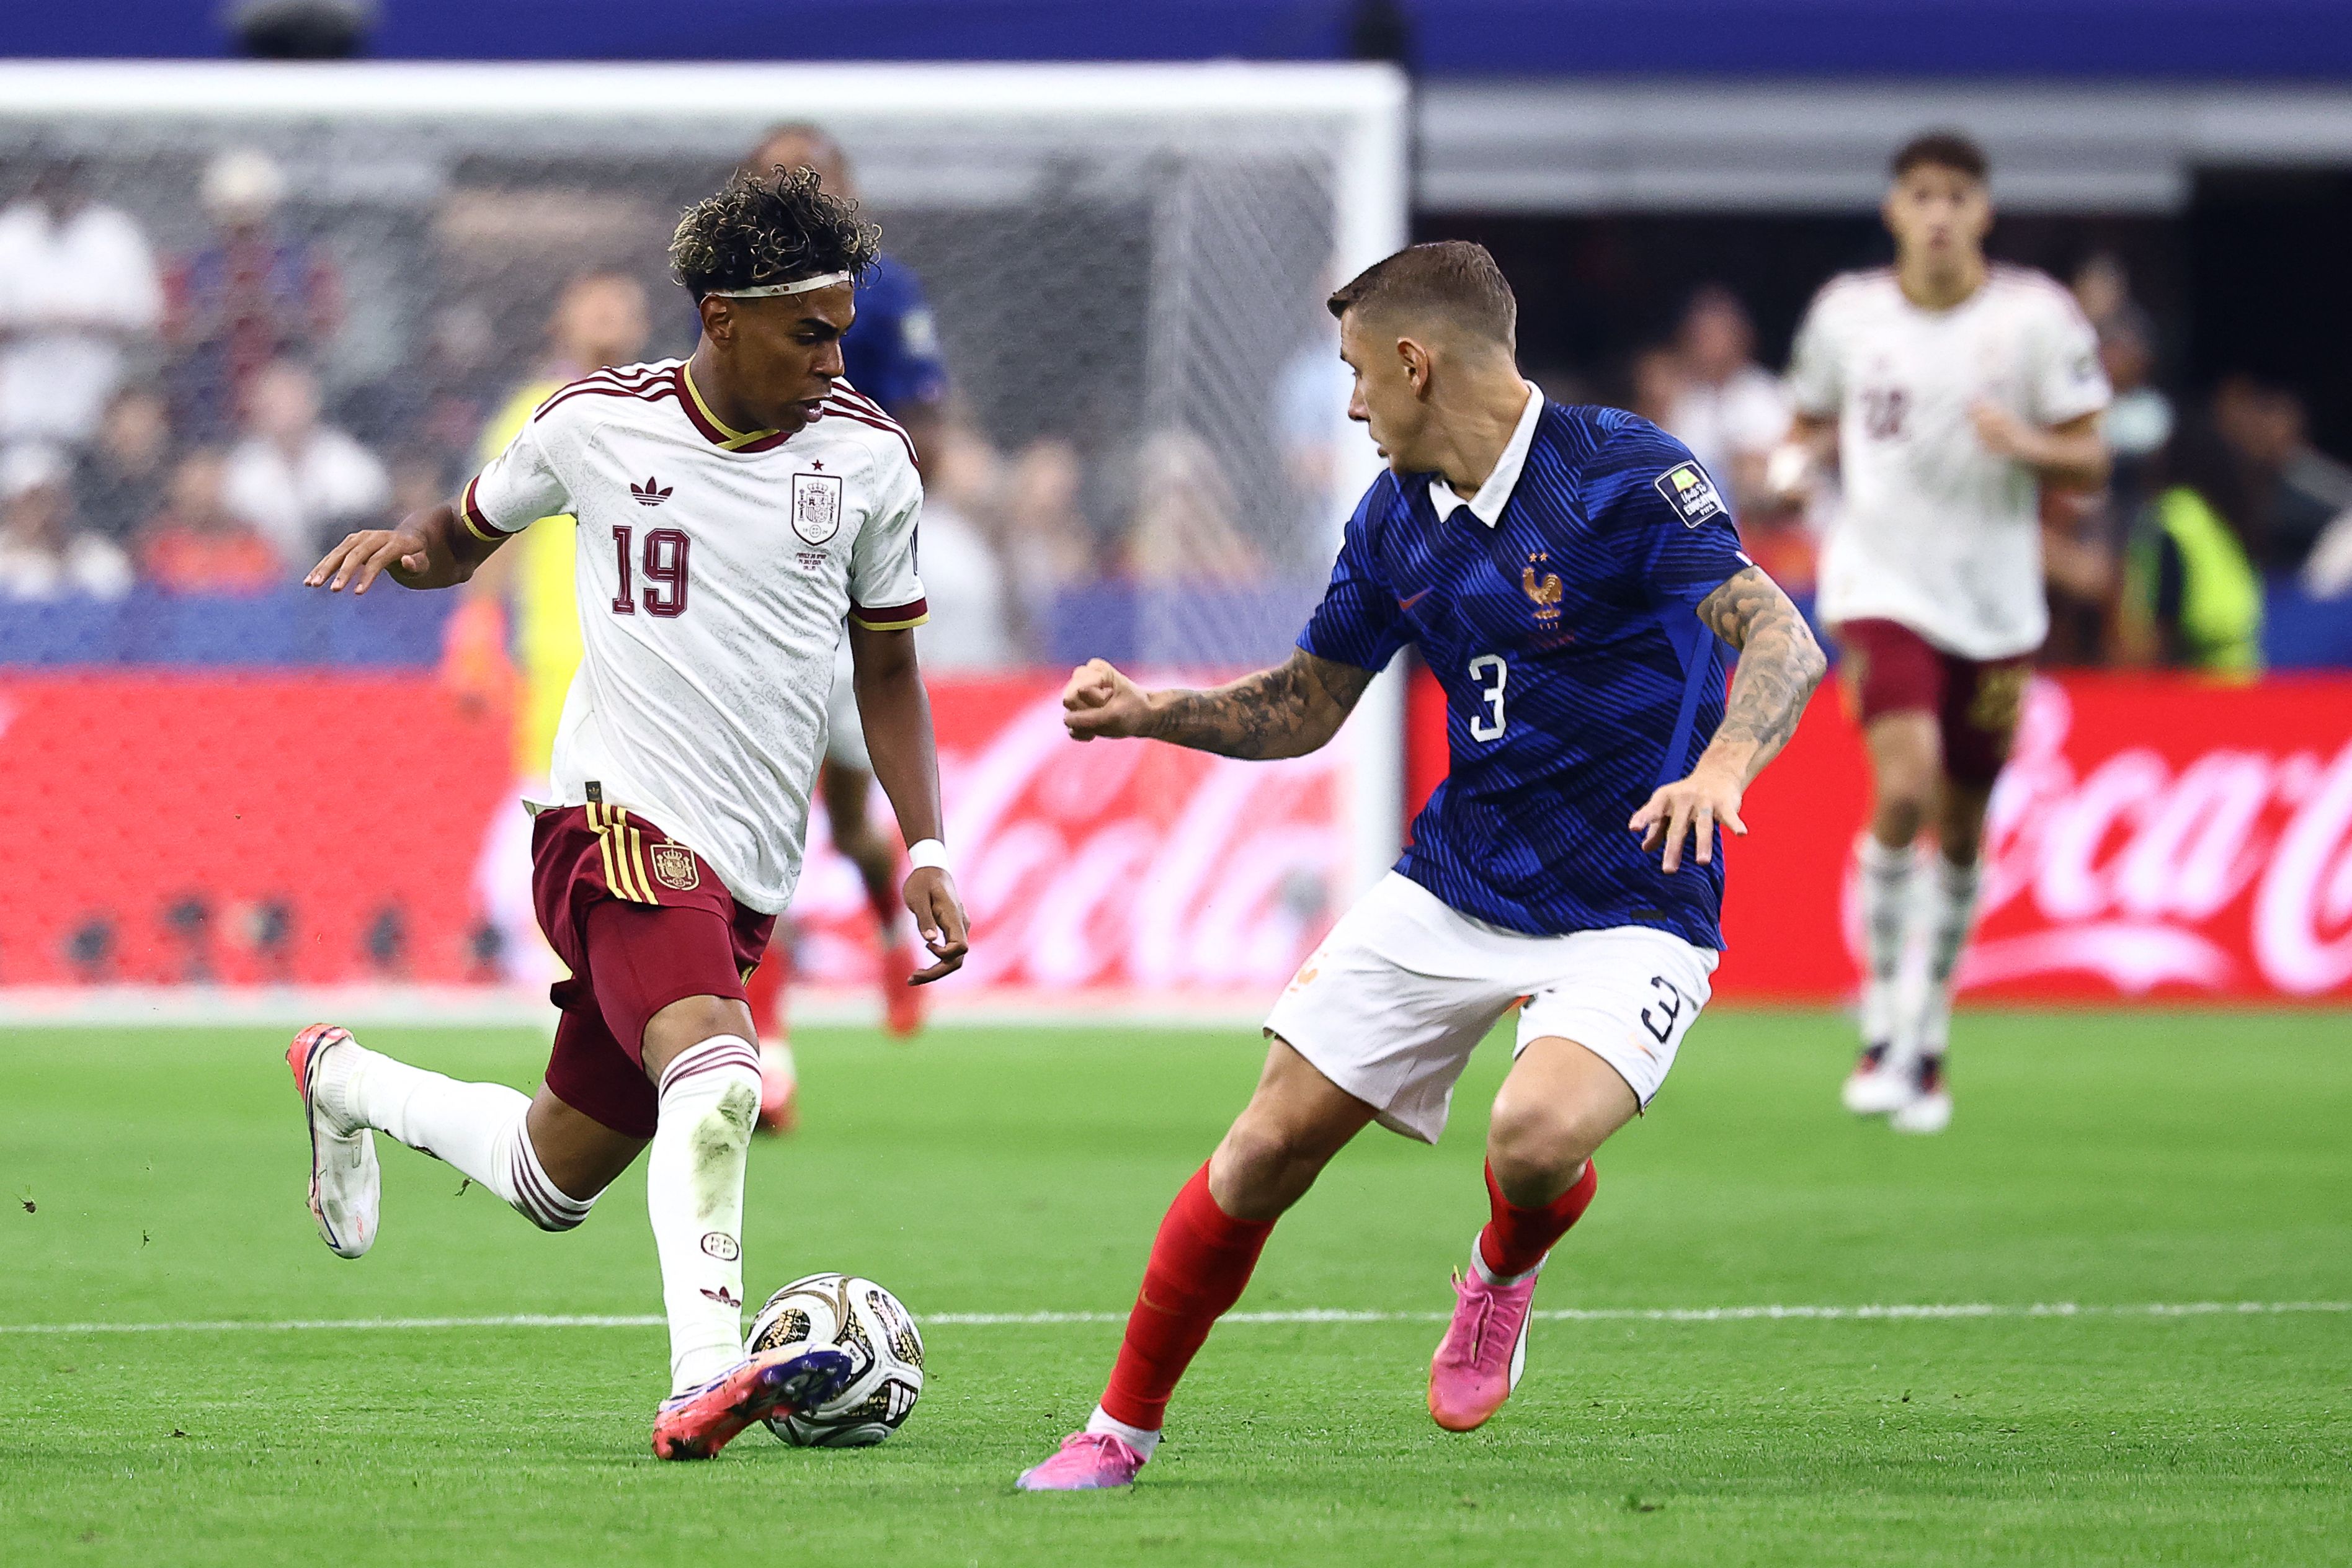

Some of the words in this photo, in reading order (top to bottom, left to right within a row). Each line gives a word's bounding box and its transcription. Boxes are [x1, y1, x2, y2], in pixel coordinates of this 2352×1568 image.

[612, 525, 690, 618] 19
[1469, 654, 1507, 742] 3
[1641, 976, 1680, 1044] 3
